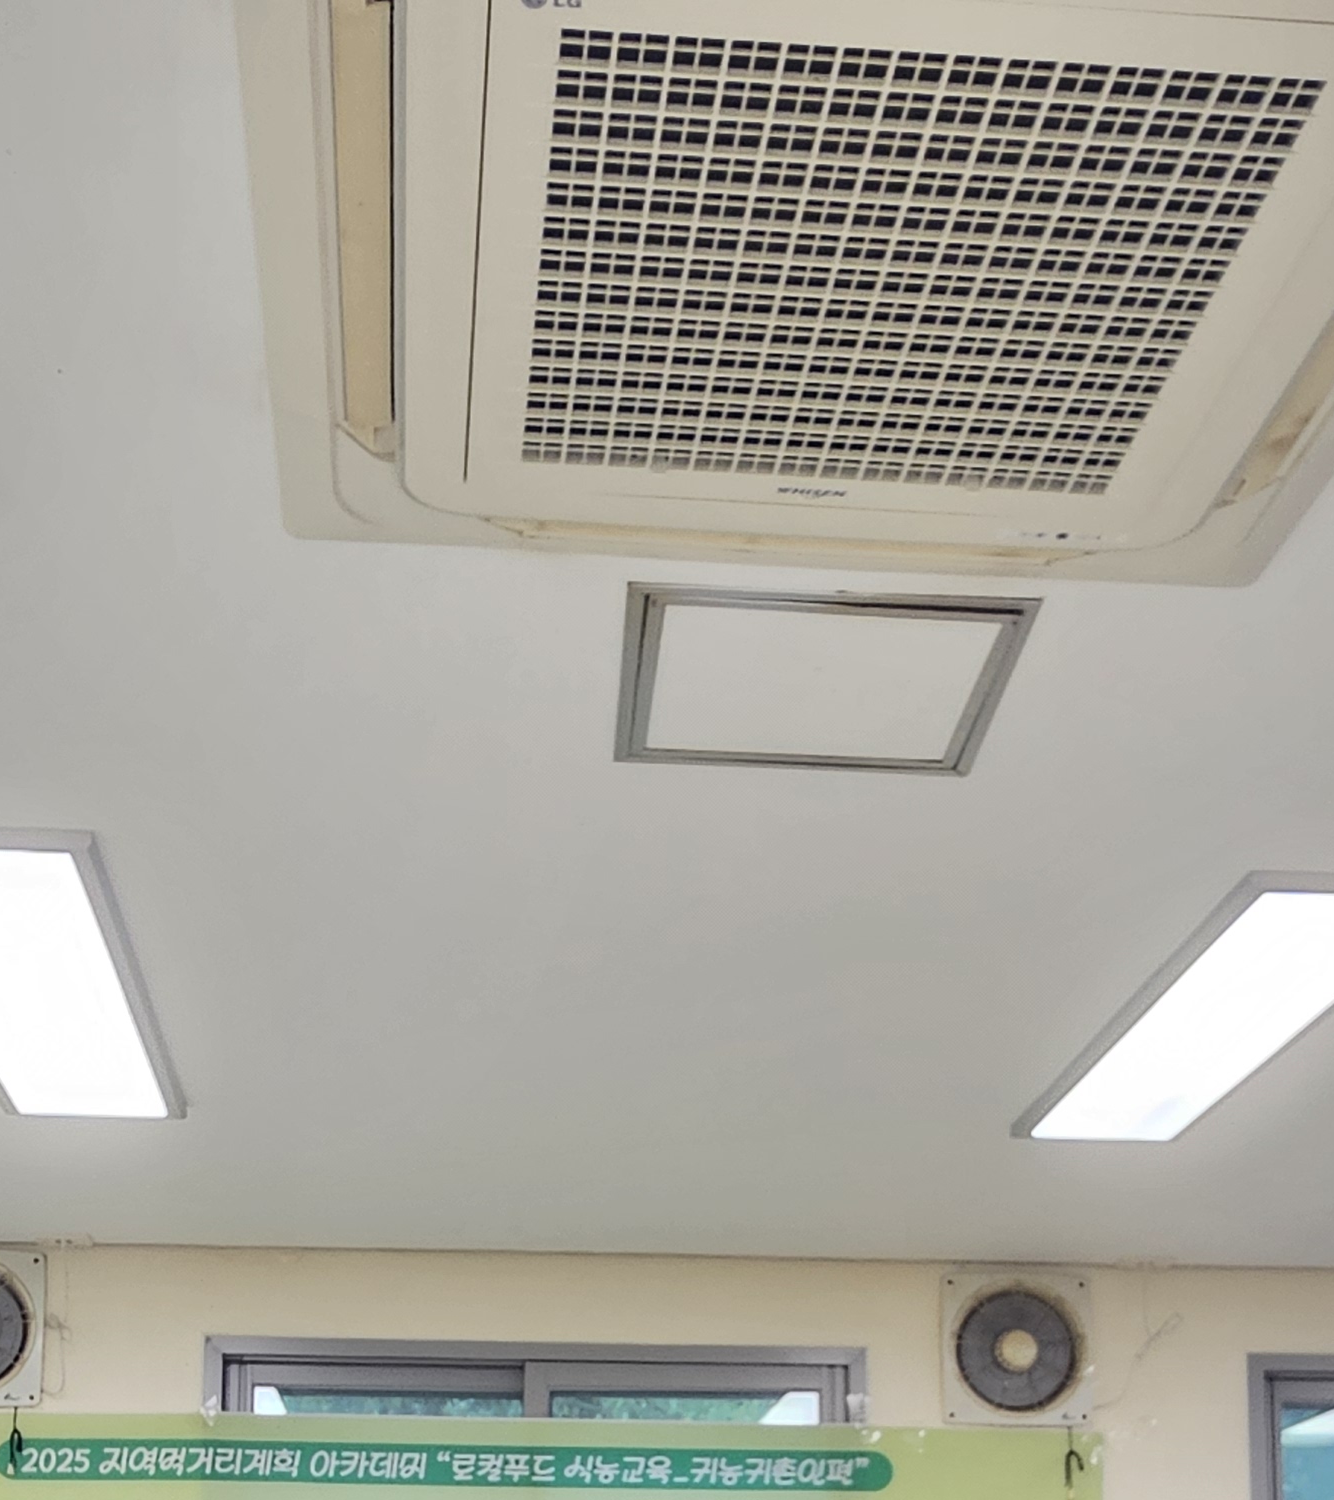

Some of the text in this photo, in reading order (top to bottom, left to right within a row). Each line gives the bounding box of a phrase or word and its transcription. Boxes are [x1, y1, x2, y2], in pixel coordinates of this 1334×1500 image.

[20, 1447, 91, 1474] 2025
[98, 1446, 300, 1478] 지역먹거리계획
[310, 1449, 427, 1480] 아카데미
